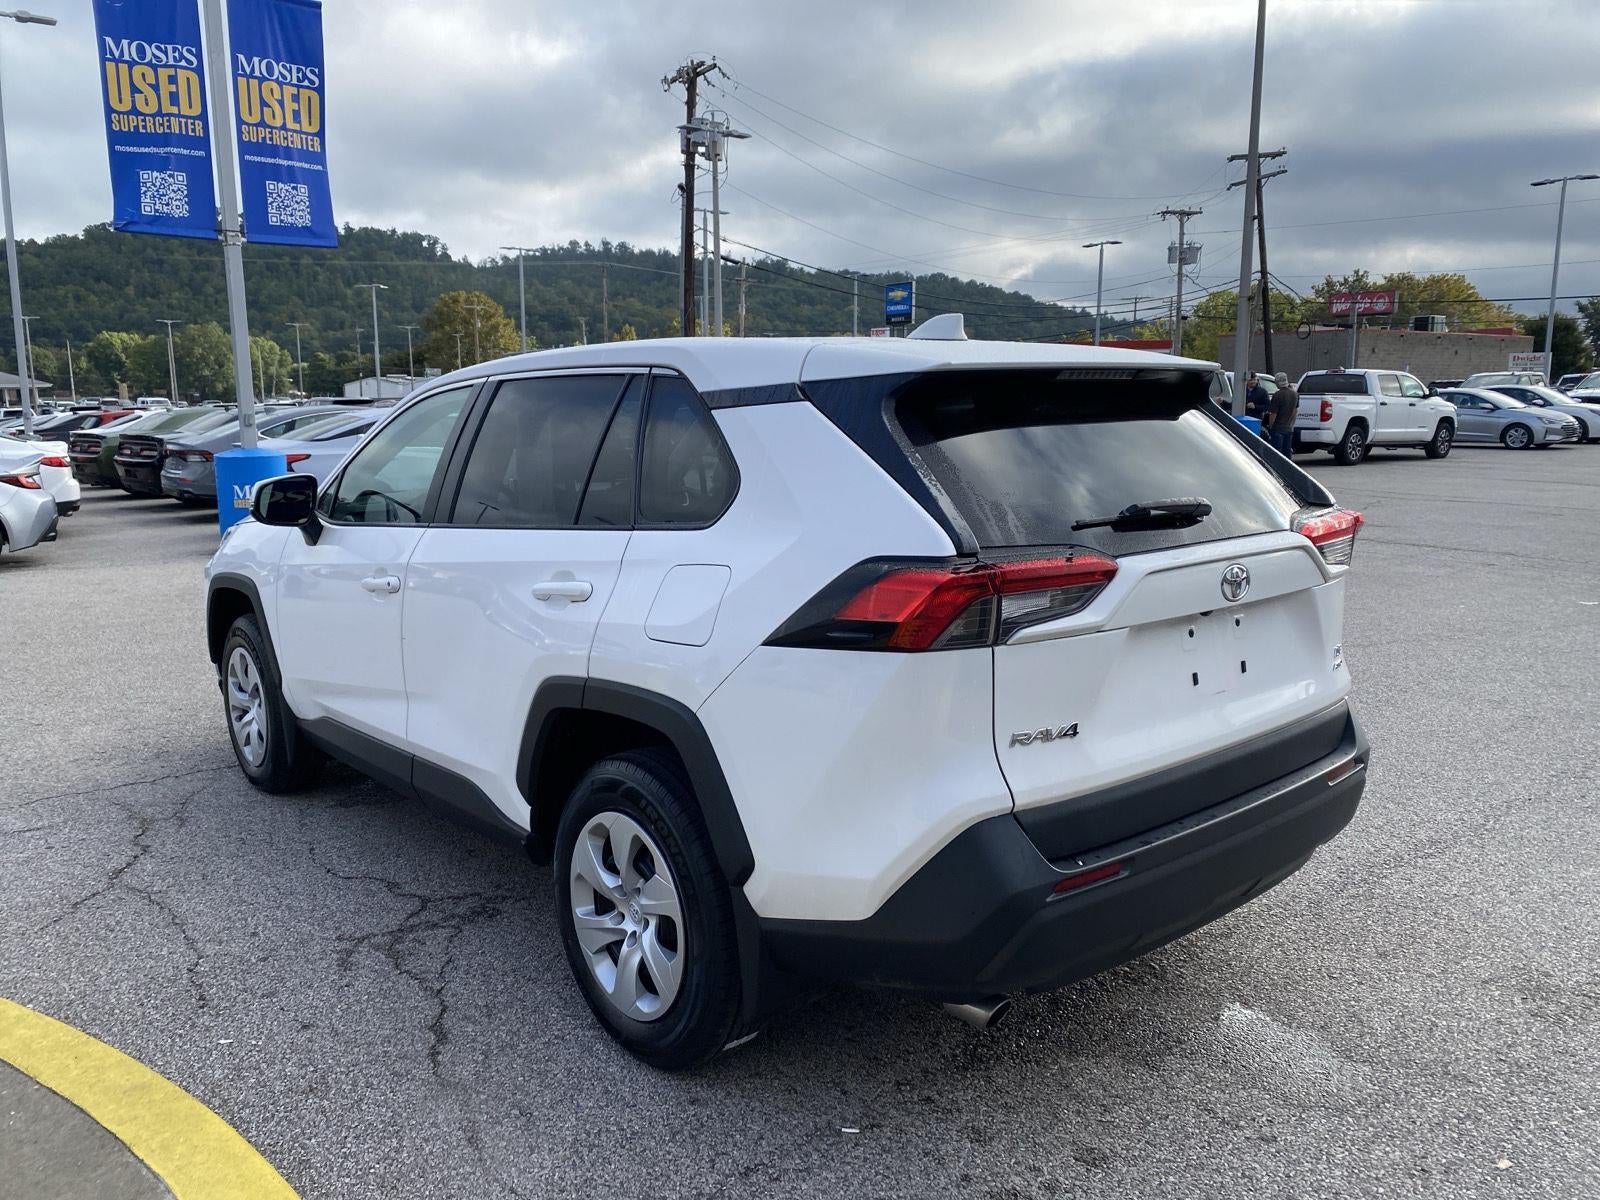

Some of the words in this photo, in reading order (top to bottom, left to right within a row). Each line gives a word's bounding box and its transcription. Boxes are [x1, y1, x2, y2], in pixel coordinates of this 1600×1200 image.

[103, 35, 197, 68] MOSES
[236, 53, 320, 88] MOSES
[105, 61, 202, 116] USED
[238, 76, 320, 133] USED
[111, 113, 204, 137] SUPERCENTER
[241, 124, 321, 153] SUPERCENTER
[114, 145, 206, 157] mosesusedsupercenter.com
[244, 154, 323, 171] mosesusedsupercenter.com
[1008, 720, 1080, 749] RAV4
